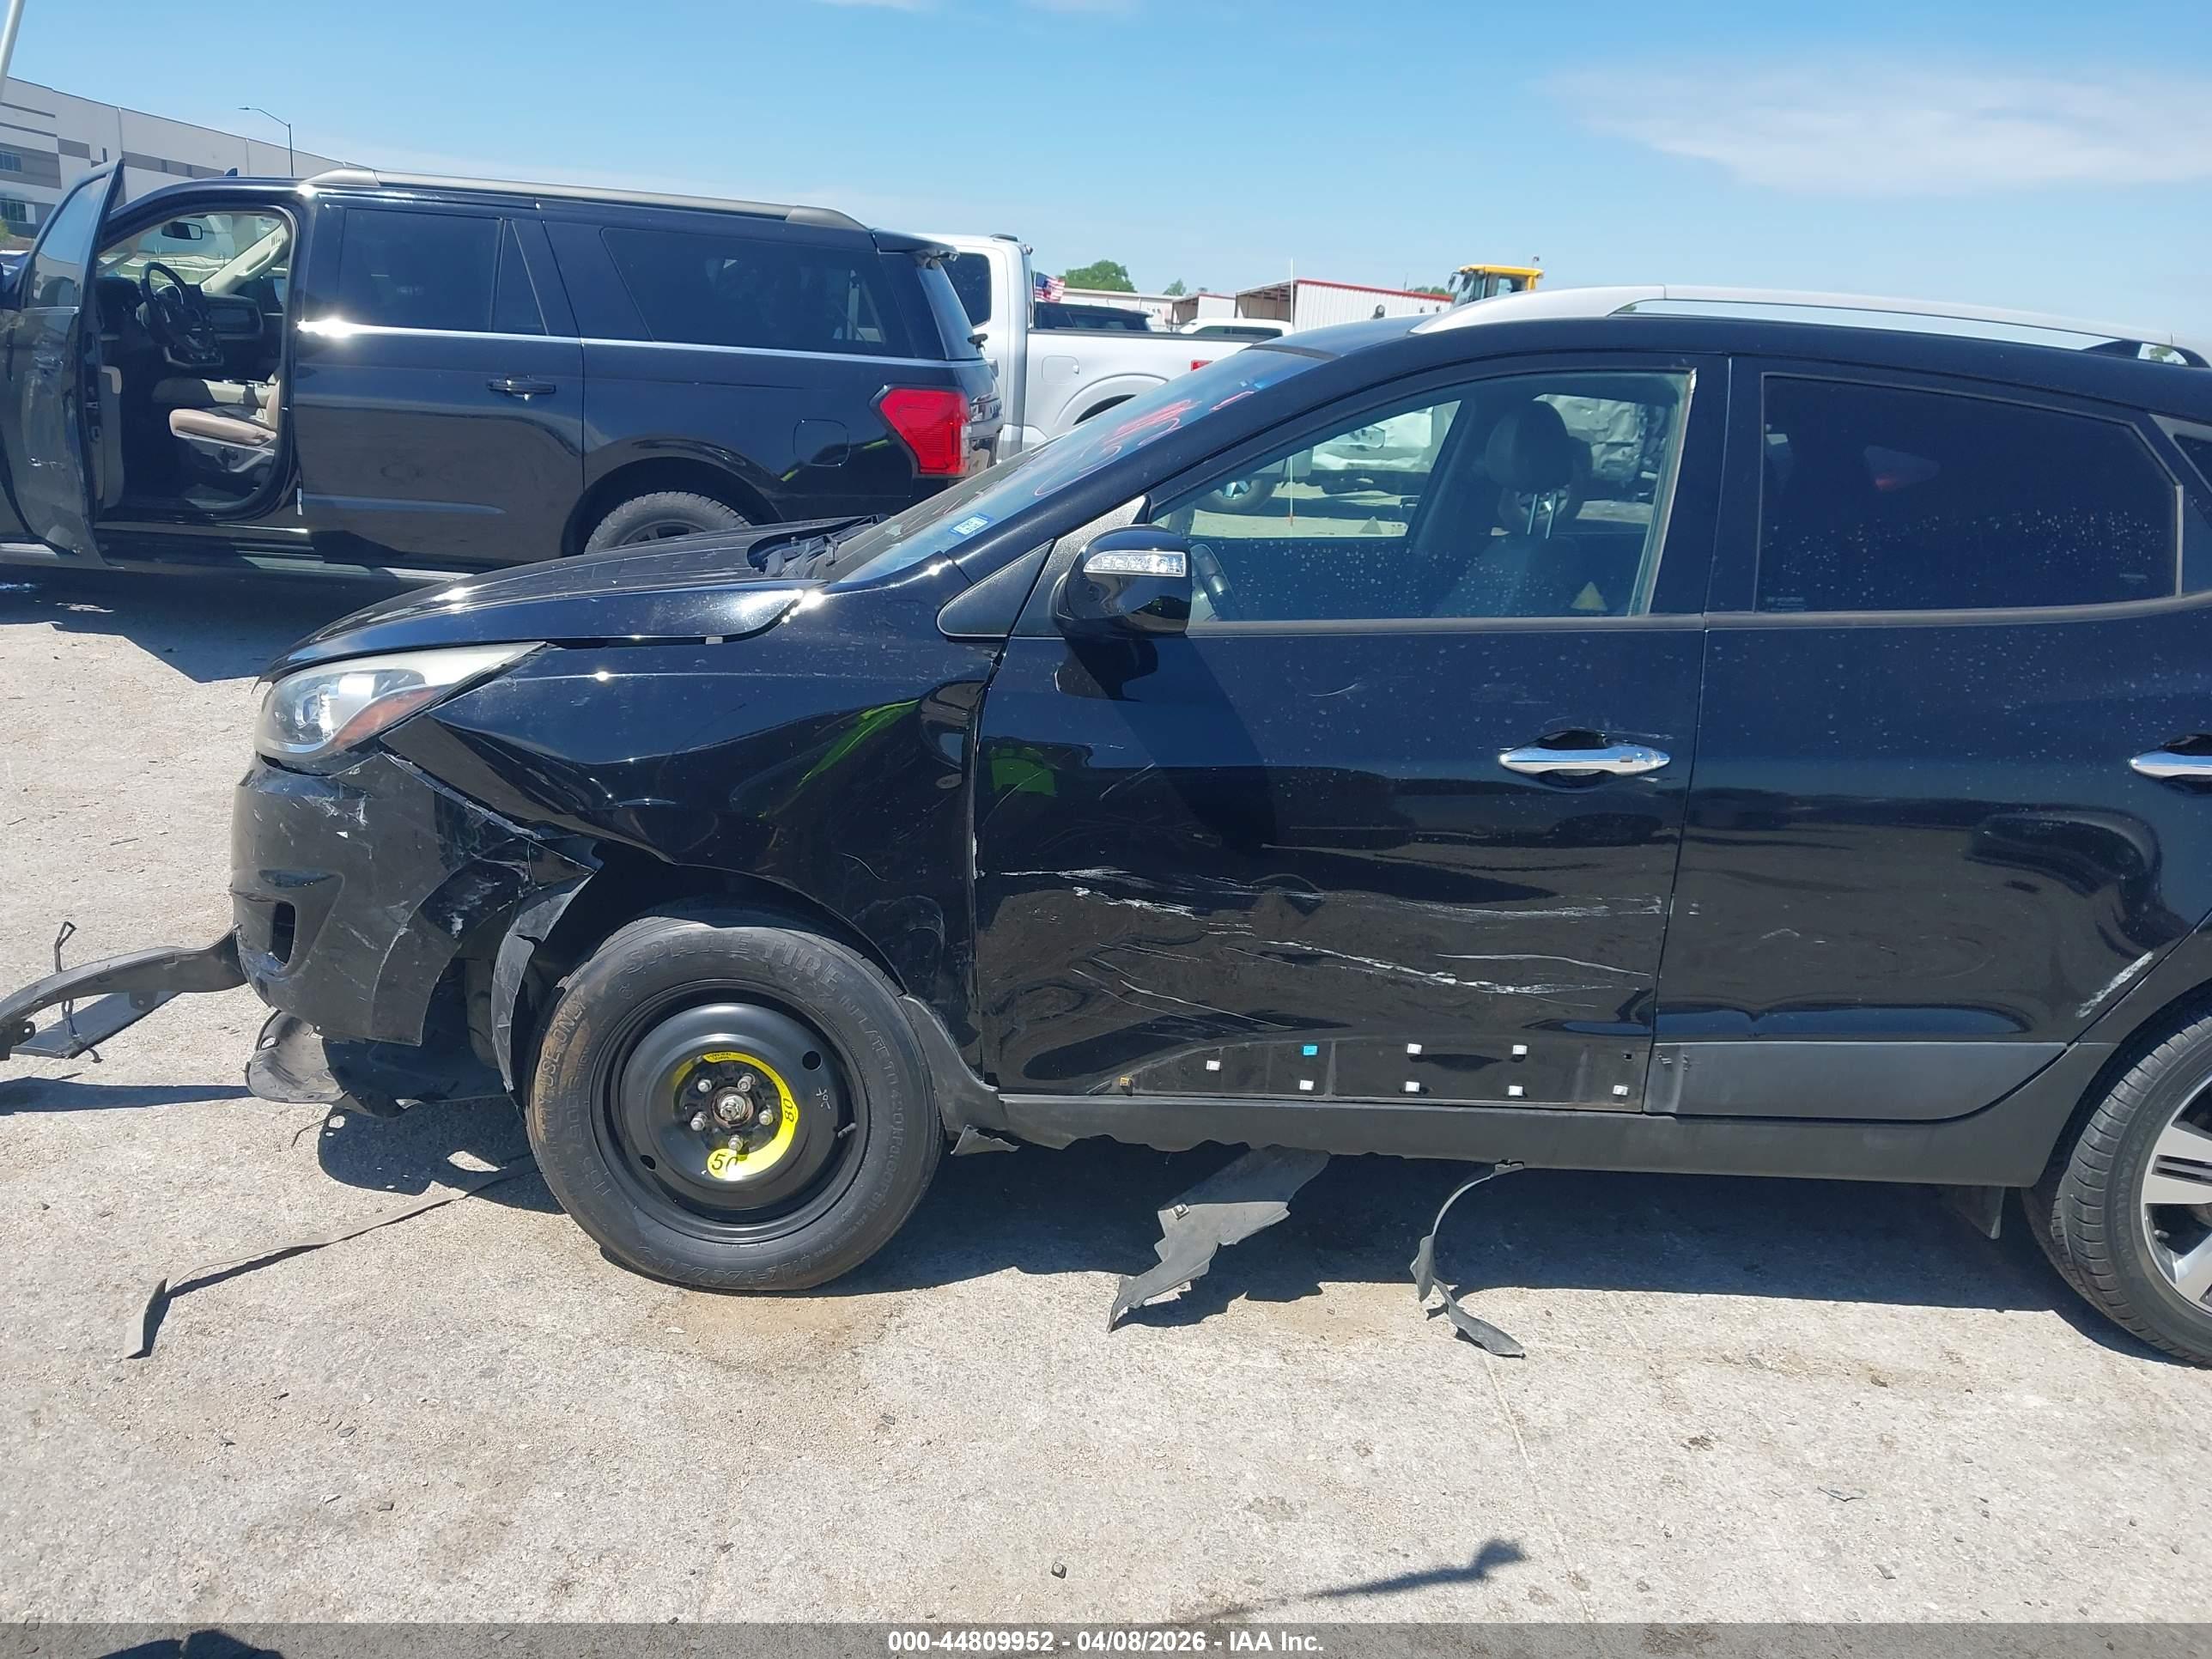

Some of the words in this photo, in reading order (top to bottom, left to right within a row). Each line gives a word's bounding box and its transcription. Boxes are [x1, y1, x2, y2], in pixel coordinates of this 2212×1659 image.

[621, 930, 753, 975] SPARE
[762, 940, 846, 992] TIRE
[540, 1046, 561, 1088] USE
[554, 993, 587, 1045] ONLY
